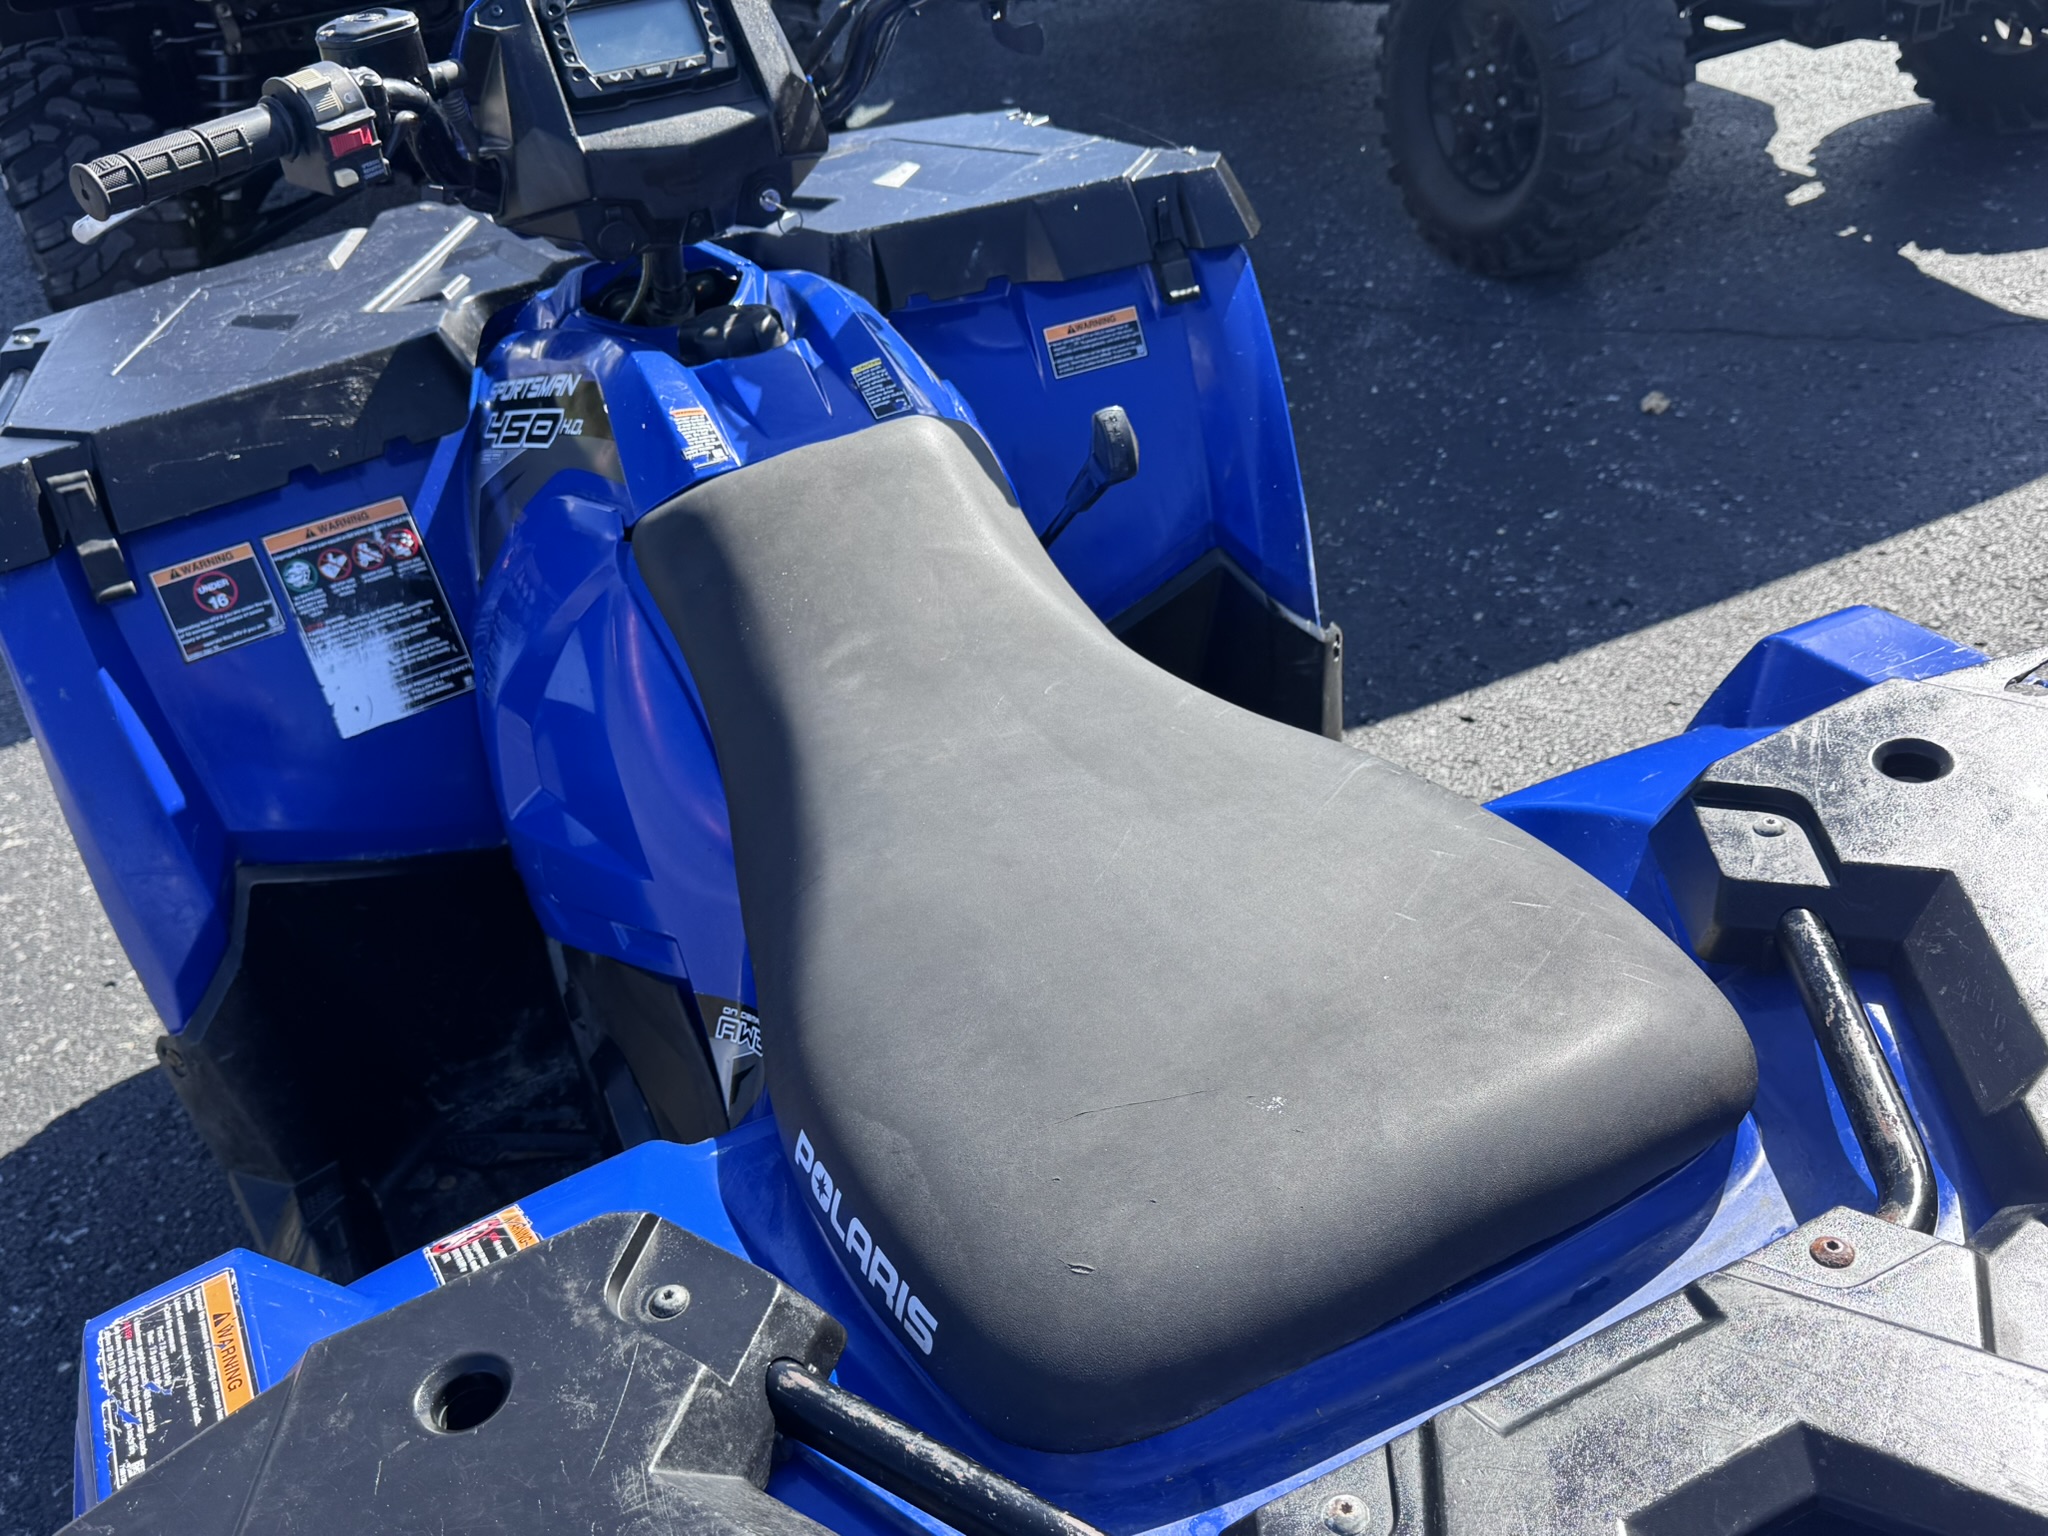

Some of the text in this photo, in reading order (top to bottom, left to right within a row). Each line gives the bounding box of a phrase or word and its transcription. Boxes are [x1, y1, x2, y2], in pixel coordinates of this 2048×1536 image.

[1076, 315, 1116, 332] WARNING
[490, 374, 582, 401] SPORTSMAN
[484, 408, 584, 449] 450 H.O.
[317, 511, 369, 534] WARNING
[181, 552, 234, 574] WARNING
[207, 592, 229, 610] 16
[794, 1128, 939, 1355] POLARIS
[216, 1322, 243, 1392] WARNING
